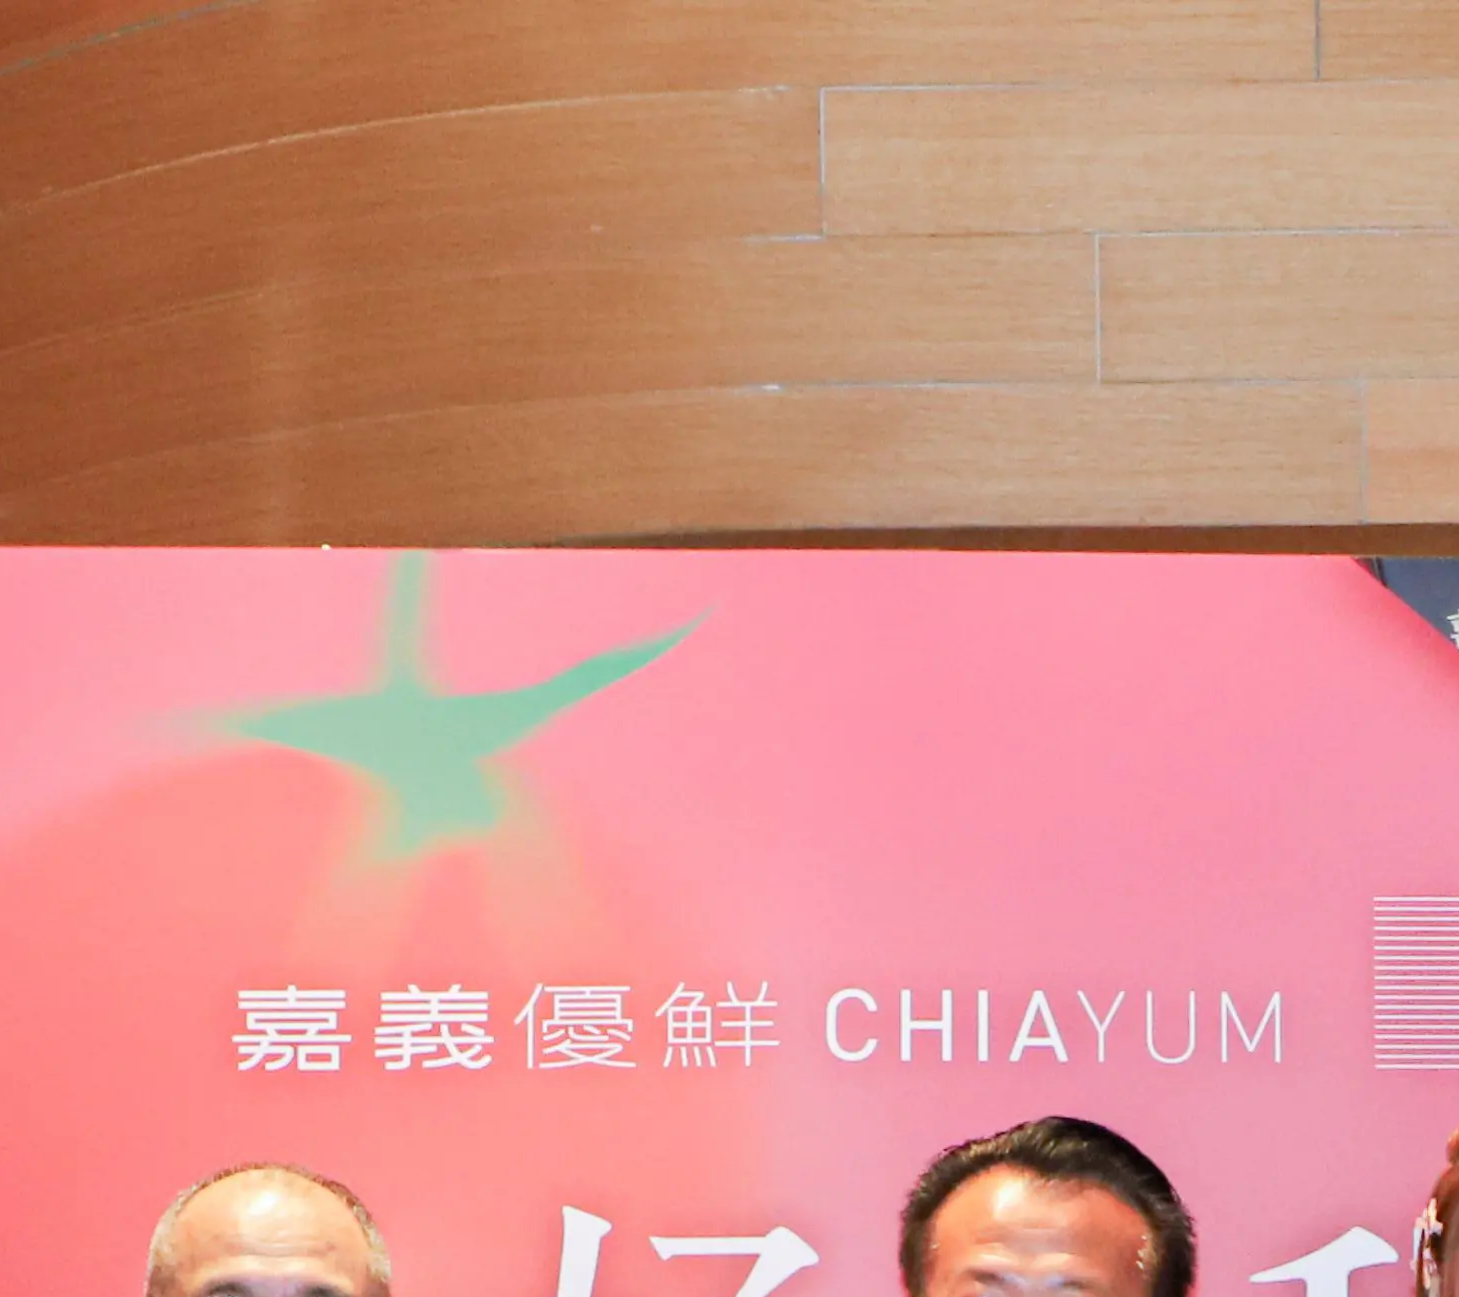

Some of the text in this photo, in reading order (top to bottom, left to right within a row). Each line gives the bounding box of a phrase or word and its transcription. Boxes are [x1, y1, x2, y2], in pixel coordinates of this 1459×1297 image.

[231, 978, 1282, 1072] 嘉義優鮮 CHIAYUM
